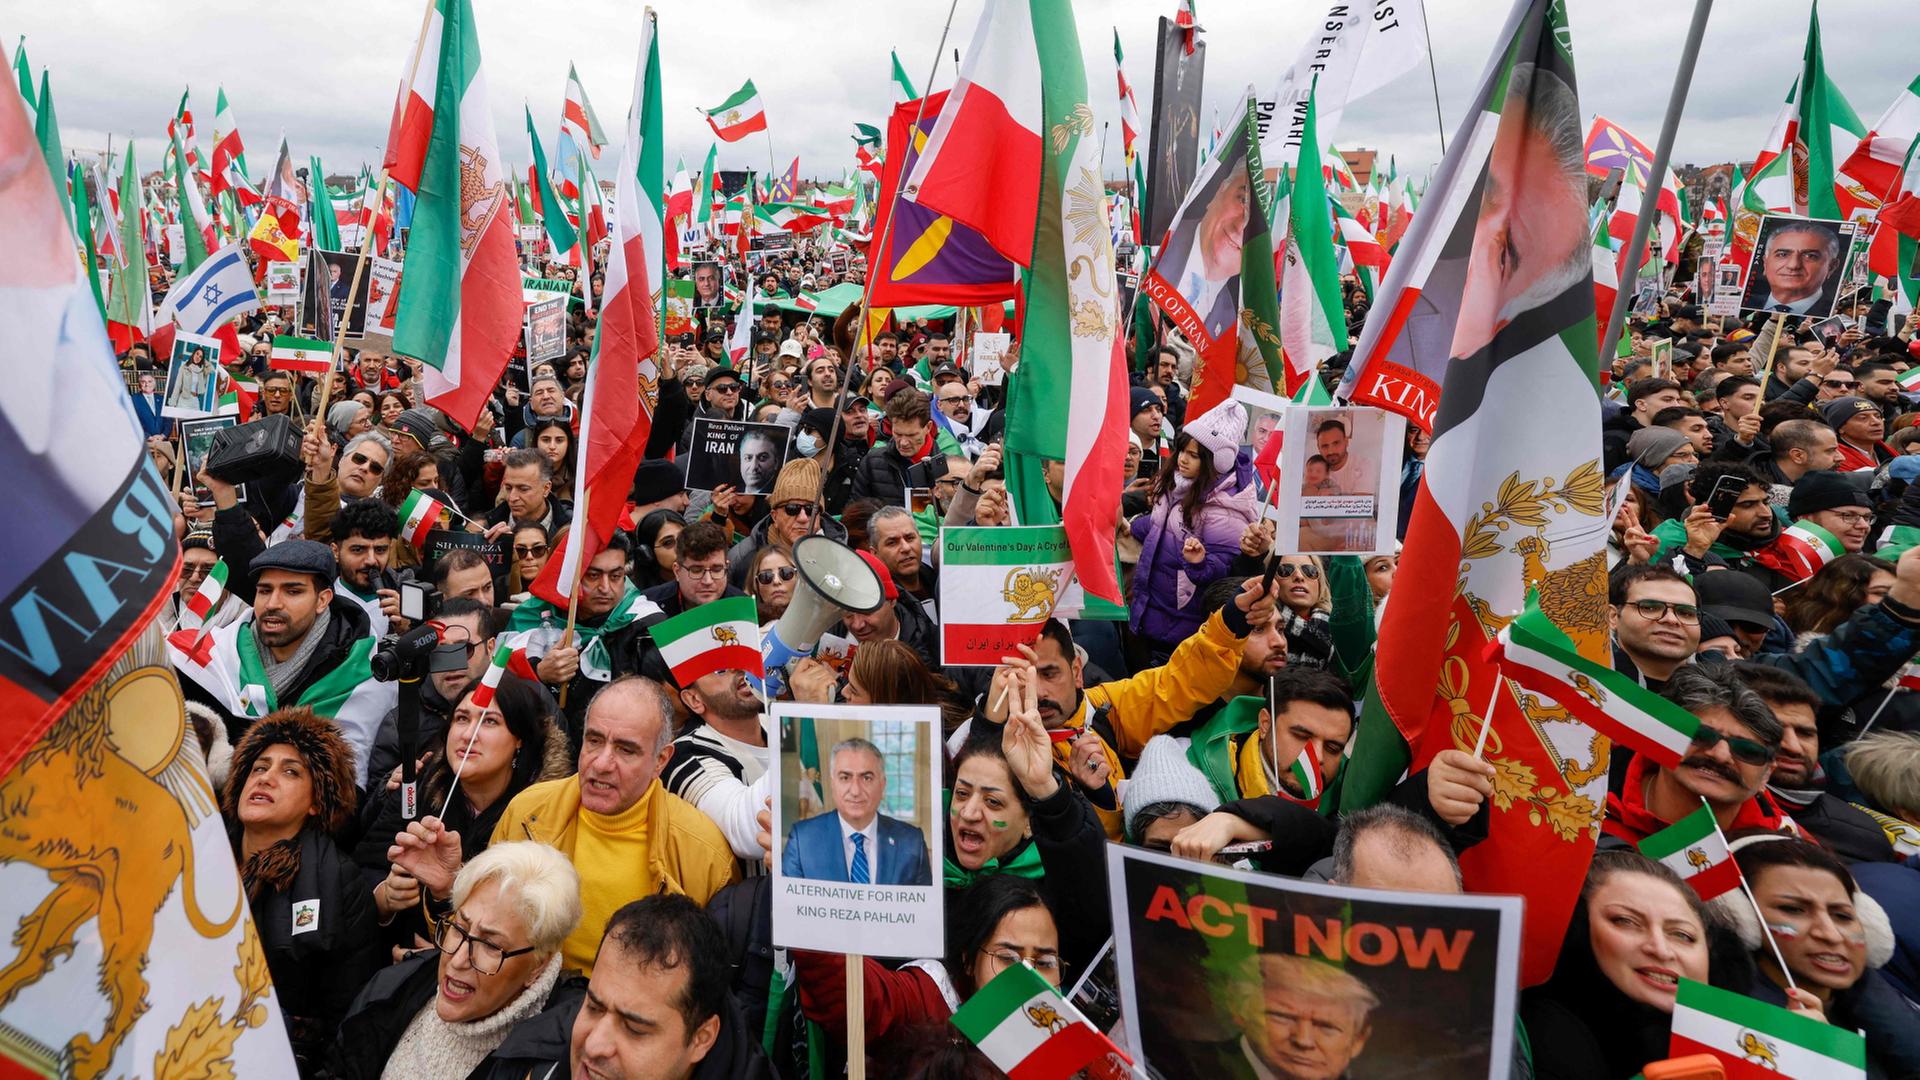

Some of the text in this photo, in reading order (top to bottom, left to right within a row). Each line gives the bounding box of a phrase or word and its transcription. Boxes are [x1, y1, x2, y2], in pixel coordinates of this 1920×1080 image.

[524, 279, 570, 292] IRANIAN
[1165, 297, 1187, 316] OF
[1181, 316, 1209, 353] IRAN
[724, 423, 745, 432] Pahlavi
[705, 441, 735, 454] IRAN
[948, 541, 1066, 553] Our Valentine's Day: A Cry of
[413, 631, 438, 649] RØDE
[967, 637, 990, 650] ایران
[993, 637, 1014, 650] برای
[786, 883, 926, 903] ALTERNATIVE FOR IRAN
[797, 905, 916, 924] KING REZA PAHLAVI
[1145, 885, 1475, 971] ACT NOW
